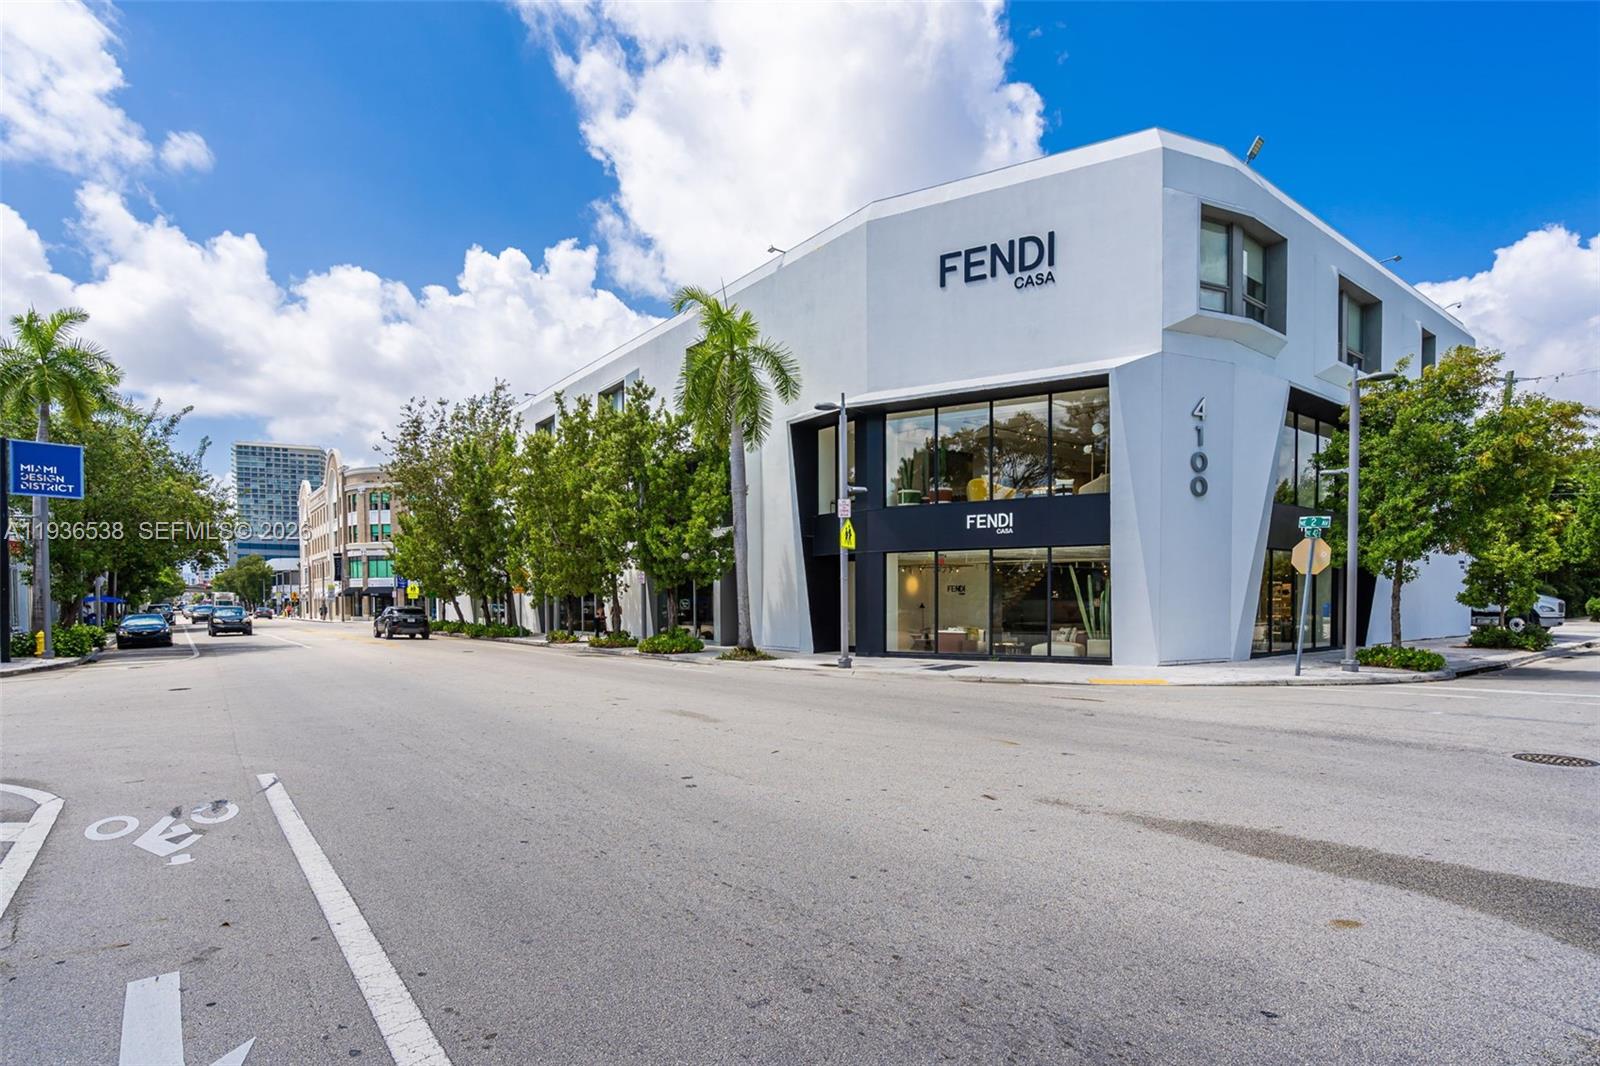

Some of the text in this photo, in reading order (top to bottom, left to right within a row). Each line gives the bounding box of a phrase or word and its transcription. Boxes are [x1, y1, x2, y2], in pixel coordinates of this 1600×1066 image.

[939, 230, 1055, 288] FENDI
[1014, 271, 1055, 289] CASA
[1190, 396, 1208, 497] 4100
[20, 463, 57, 474] MIAMI
[20, 472, 64, 483] DESIGN
[20, 481, 75, 493] DISTRICT
[966, 512, 1013, 529] FENDI
[1311, 518, 1317, 527] 2
